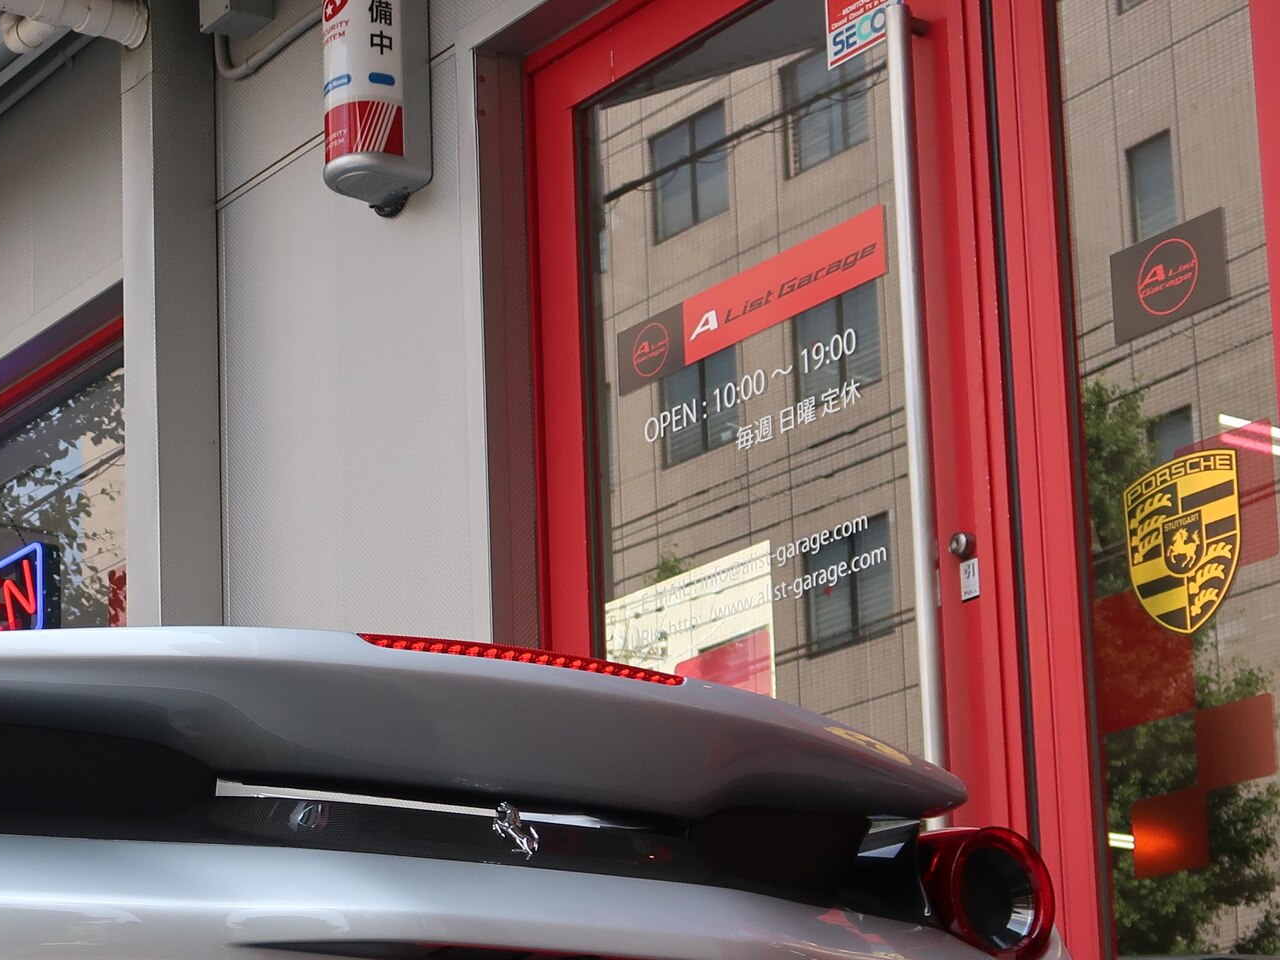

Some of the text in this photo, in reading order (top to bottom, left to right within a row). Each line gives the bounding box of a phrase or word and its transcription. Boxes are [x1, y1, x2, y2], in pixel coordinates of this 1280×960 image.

[833, 5, 888, 57] SECO
[690, 242, 878, 341] A List Garage
[1138, 264, 1167, 290] A
[644, 398, 698, 444] OPEN
[713, 369, 766, 413] 10:00
[801, 327, 857, 374] 19:00
[735, 378, 863, 451] 毎週 日曜 定休
[1127, 454, 1231, 506] PORSCHE
[1164, 512, 1200, 533] STUTTGART
